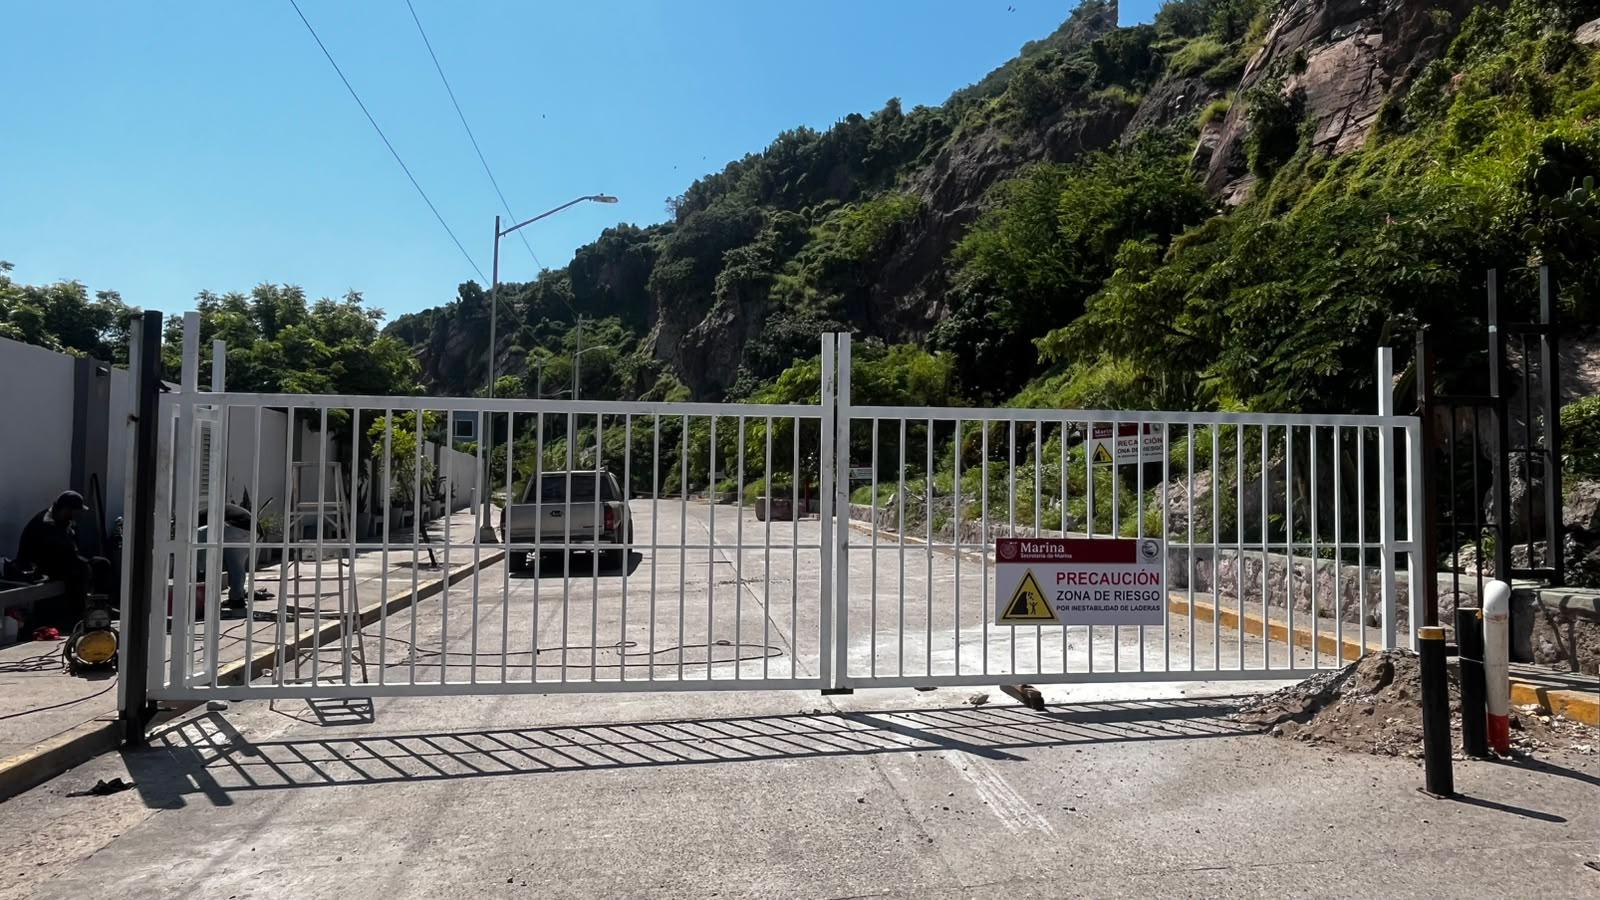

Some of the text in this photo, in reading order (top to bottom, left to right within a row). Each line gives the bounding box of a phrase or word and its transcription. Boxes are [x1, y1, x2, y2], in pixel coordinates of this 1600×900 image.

[1117, 437, 1163, 446] RECACIÓN
[1020, 542, 1065, 553] Marina
[1056, 569, 1160, 585] PRECAUCIÓN
[1056, 591, 1160, 601] ZONA DE RIESGO
